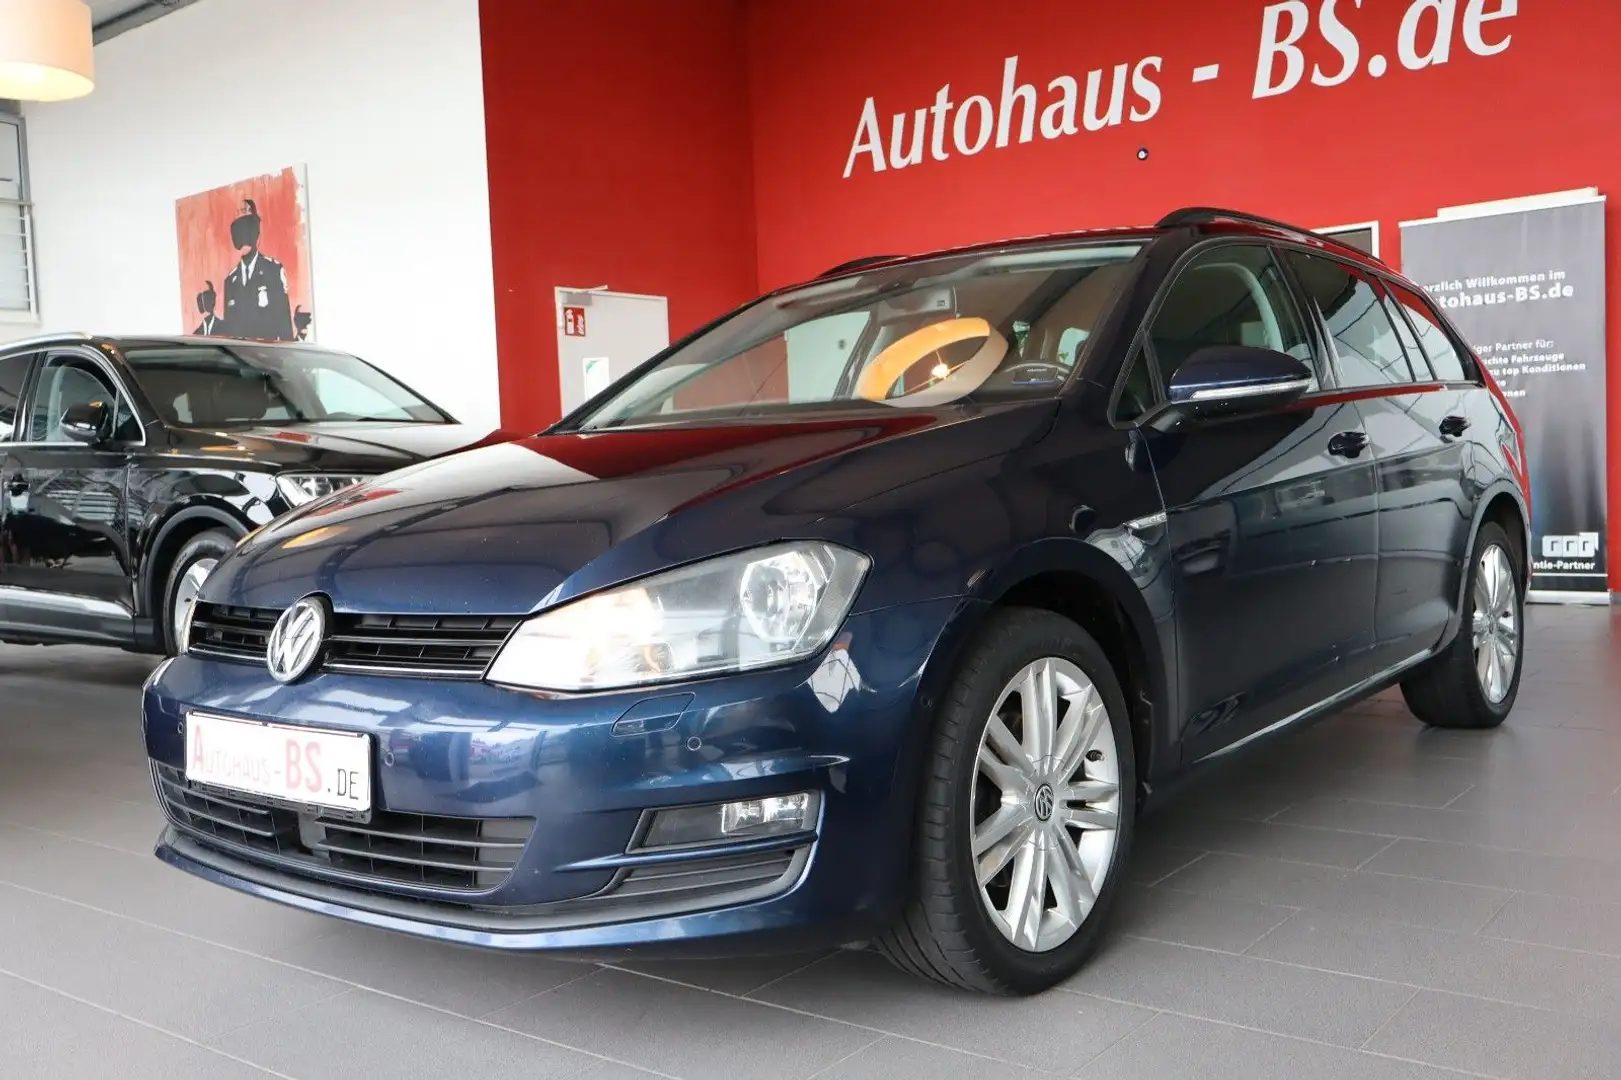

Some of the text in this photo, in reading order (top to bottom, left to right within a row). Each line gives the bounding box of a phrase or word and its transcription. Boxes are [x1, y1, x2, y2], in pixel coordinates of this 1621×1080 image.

[842, 55, 1162, 179] Autohaus
[1252, 0, 1517, 99] BS.de
[1424, 270, 1566, 293] erzlich Willkommen im
[1436, 282, 1574, 308] tohaus-BS.de
[1495, 340, 1533, 352] Partner
[1502, 366, 1519, 376] top
[1522, 362, 1586, 374] Konditionen
[1532, 560, 1596, 571] ntie-Partner
